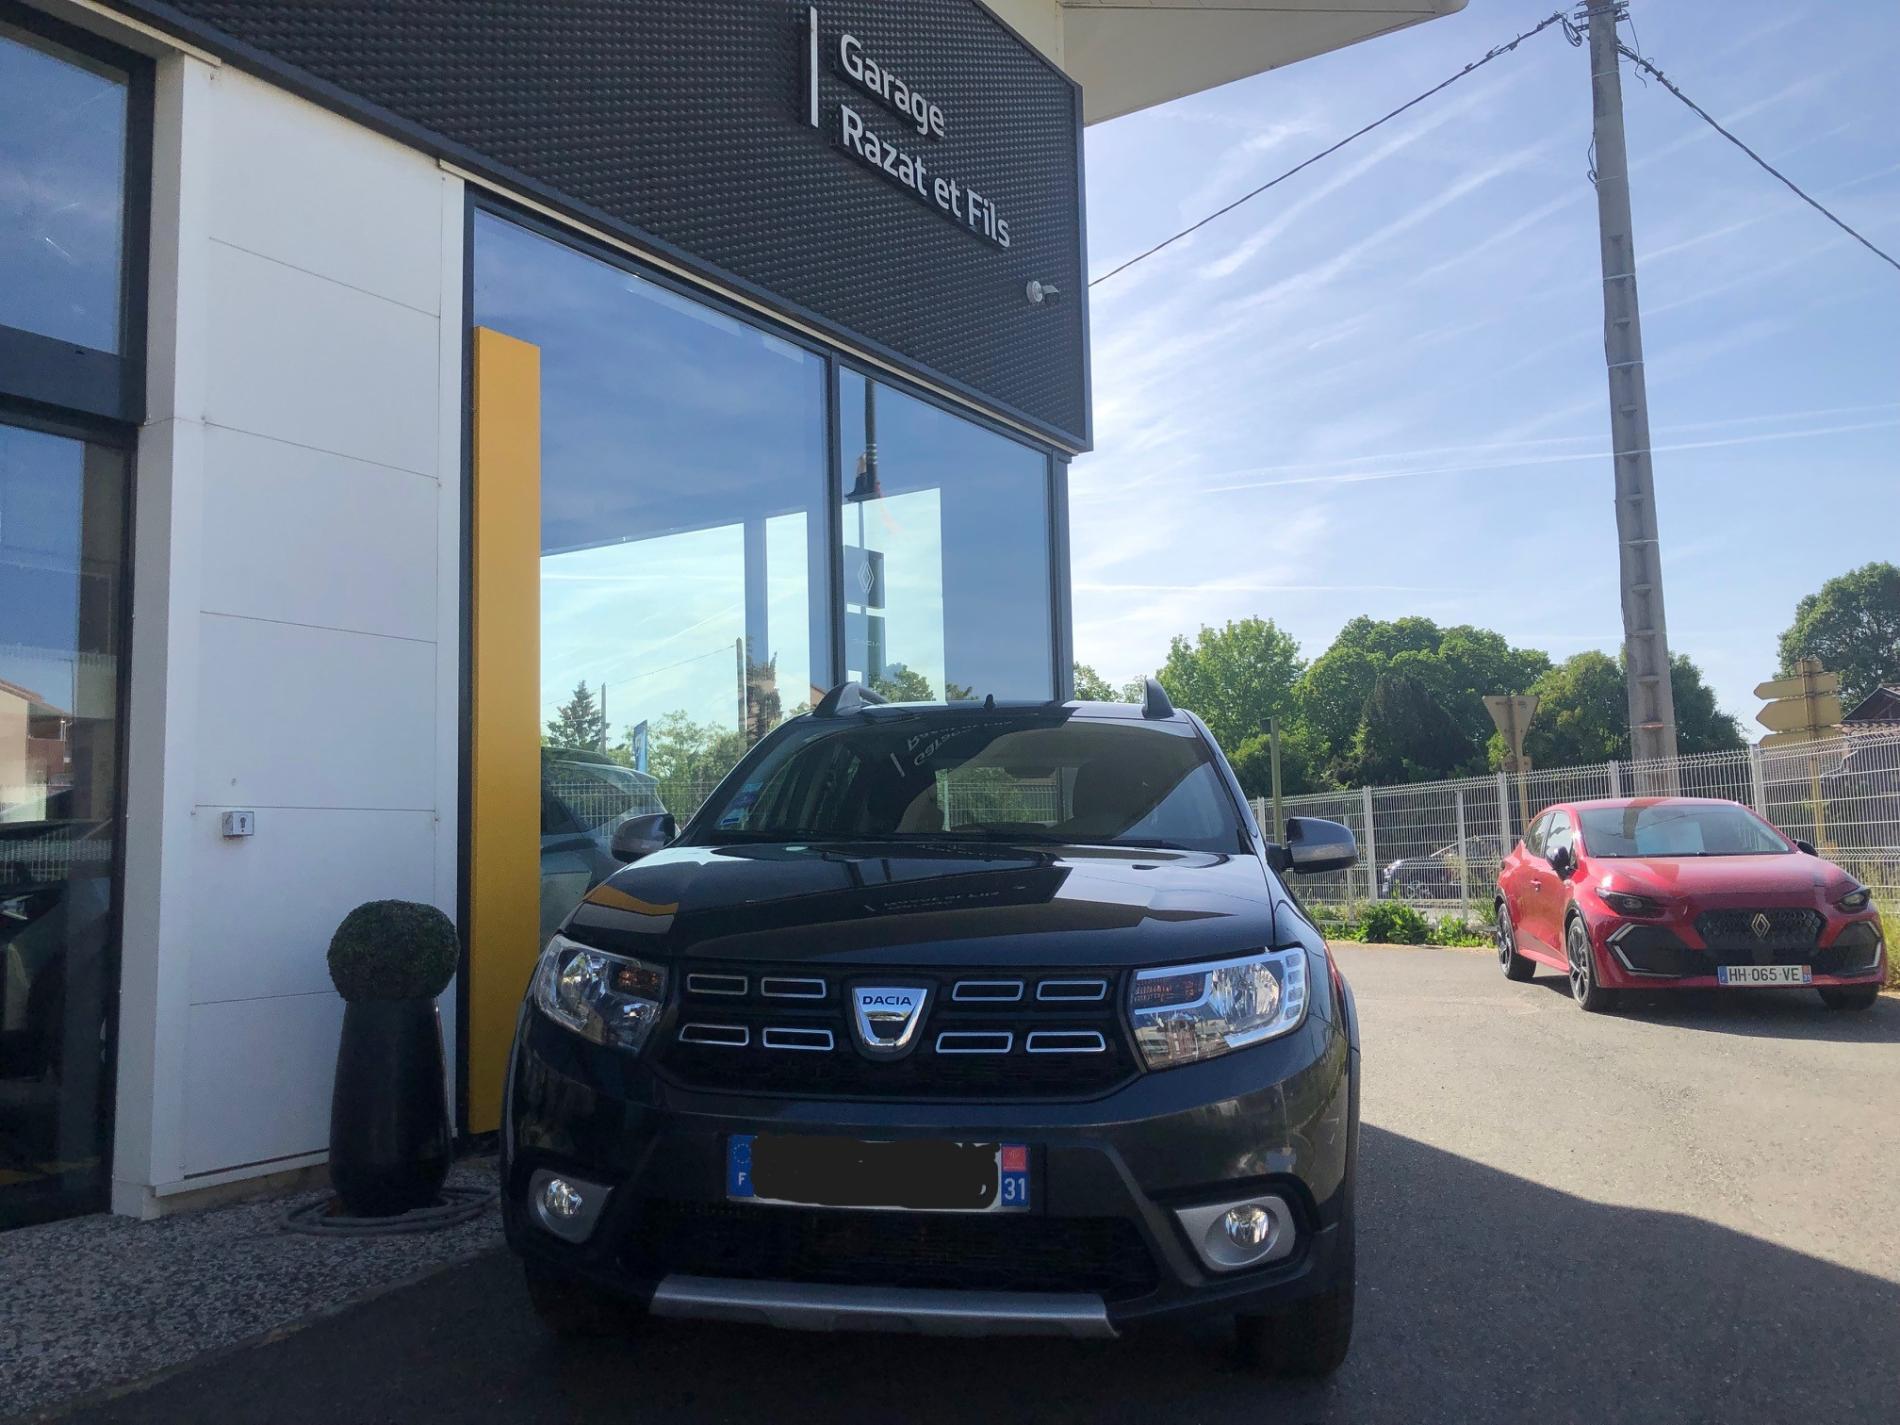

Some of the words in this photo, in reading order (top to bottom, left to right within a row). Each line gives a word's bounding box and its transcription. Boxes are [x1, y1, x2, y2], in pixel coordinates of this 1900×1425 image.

[840, 34, 945, 137] Garage
[840, 104, 928, 197] Razat
[934, 177, 962, 218] et
[966, 188, 1011, 248] Fils
[862, 995, 912, 1006] DACIA
[737, 1172, 746, 1186] F
[1004, 1177, 1026, 1201] 31
